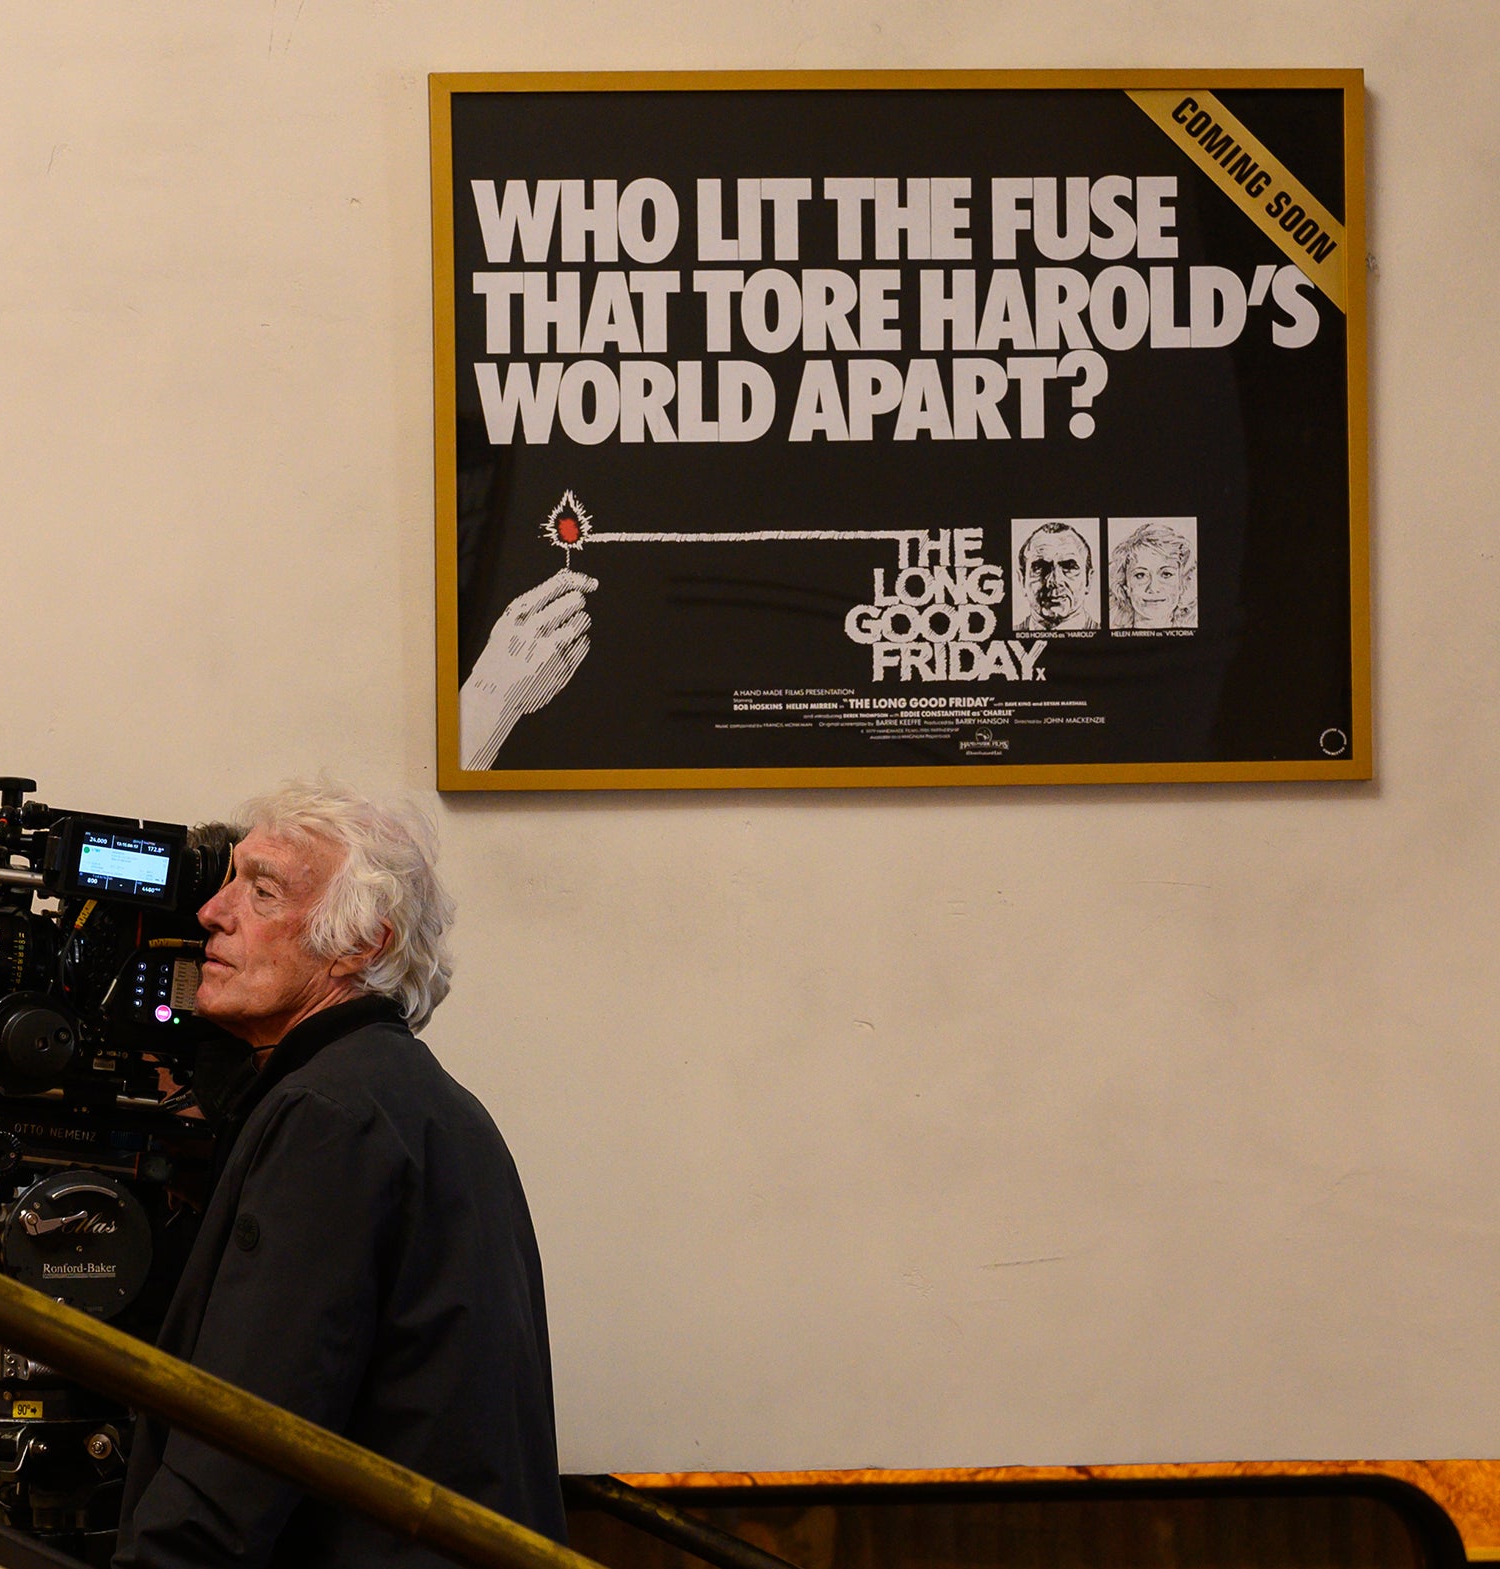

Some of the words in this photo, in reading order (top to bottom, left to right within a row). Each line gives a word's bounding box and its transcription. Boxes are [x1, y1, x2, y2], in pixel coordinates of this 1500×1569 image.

[1171, 97, 1272, 198] COMING
[1265, 191, 1338, 264] SOON
[470, 177, 680, 264] WHO
[697, 177, 812, 261] LIT
[824, 176, 972, 260] THE
[991, 174, 1179, 261] FUSE
[472, 270, 680, 354] THAT
[693, 268, 902, 354] TORE
[920, 264, 1320, 351] HAROLD'S
[473, 359, 776, 446] WORLD
[788, 350, 1109, 443] APART?
[890, 526, 985, 569] THE
[873, 565, 1006, 607] LONG
[844, 603, 998, 645] GOOD
[1015, 631, 1029, 639] BOB
[1030, 631, 1058, 639] HOSKINS
[871, 640, 1048, 682] FRIDAY
[733, 703, 749, 711] BOB
[749, 703, 783, 711] HOSKINS
[785, 703, 809, 711] HELEN
[810, 702, 838, 710] MIRREN
[872, 697, 907, 709] LONG
[909, 697, 947, 708] GOOD
[740, 689, 762, 697] HAND
[763, 689, 783, 697] MADE
[784, 689, 805, 697] FILMS
[805, 688, 855, 696] PRESENTATION
[1065, 716, 1106, 724] MACKENZIE
[14, 1122, 44, 1136] OTTO
[50, 1127, 98, 1143] NEMENZ
[43, 1261, 117, 1273] Ronford-Baker
